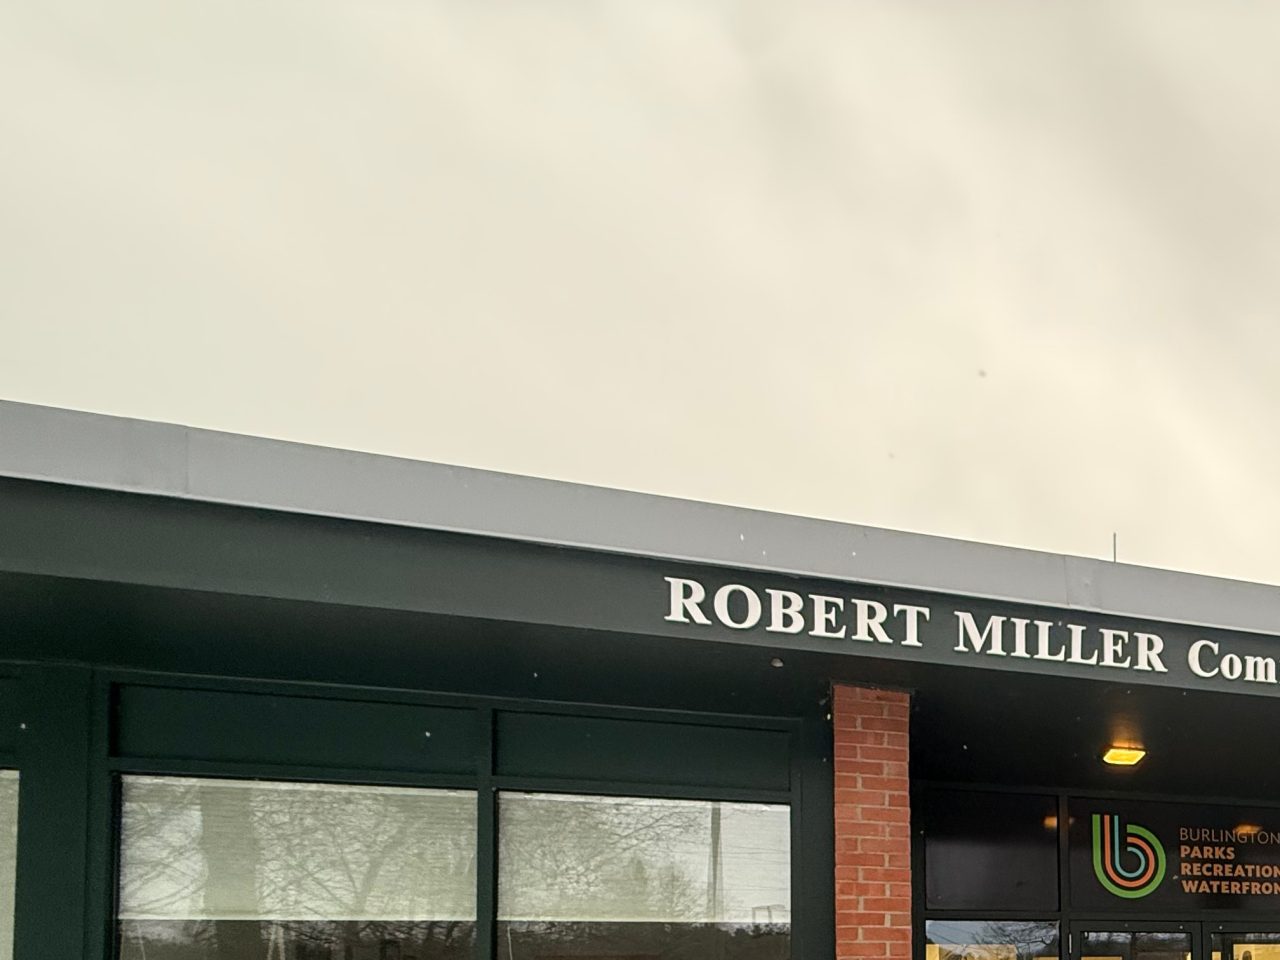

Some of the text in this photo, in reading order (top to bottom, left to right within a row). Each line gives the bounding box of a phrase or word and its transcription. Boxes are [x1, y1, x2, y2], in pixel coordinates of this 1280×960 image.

[664, 577, 930, 648] ROBERT
[953, 610, 1168, 674] MILLER
[1180, 828, 1280, 844] BURLINGTON
[1180, 845, 1235, 860] PARKS
